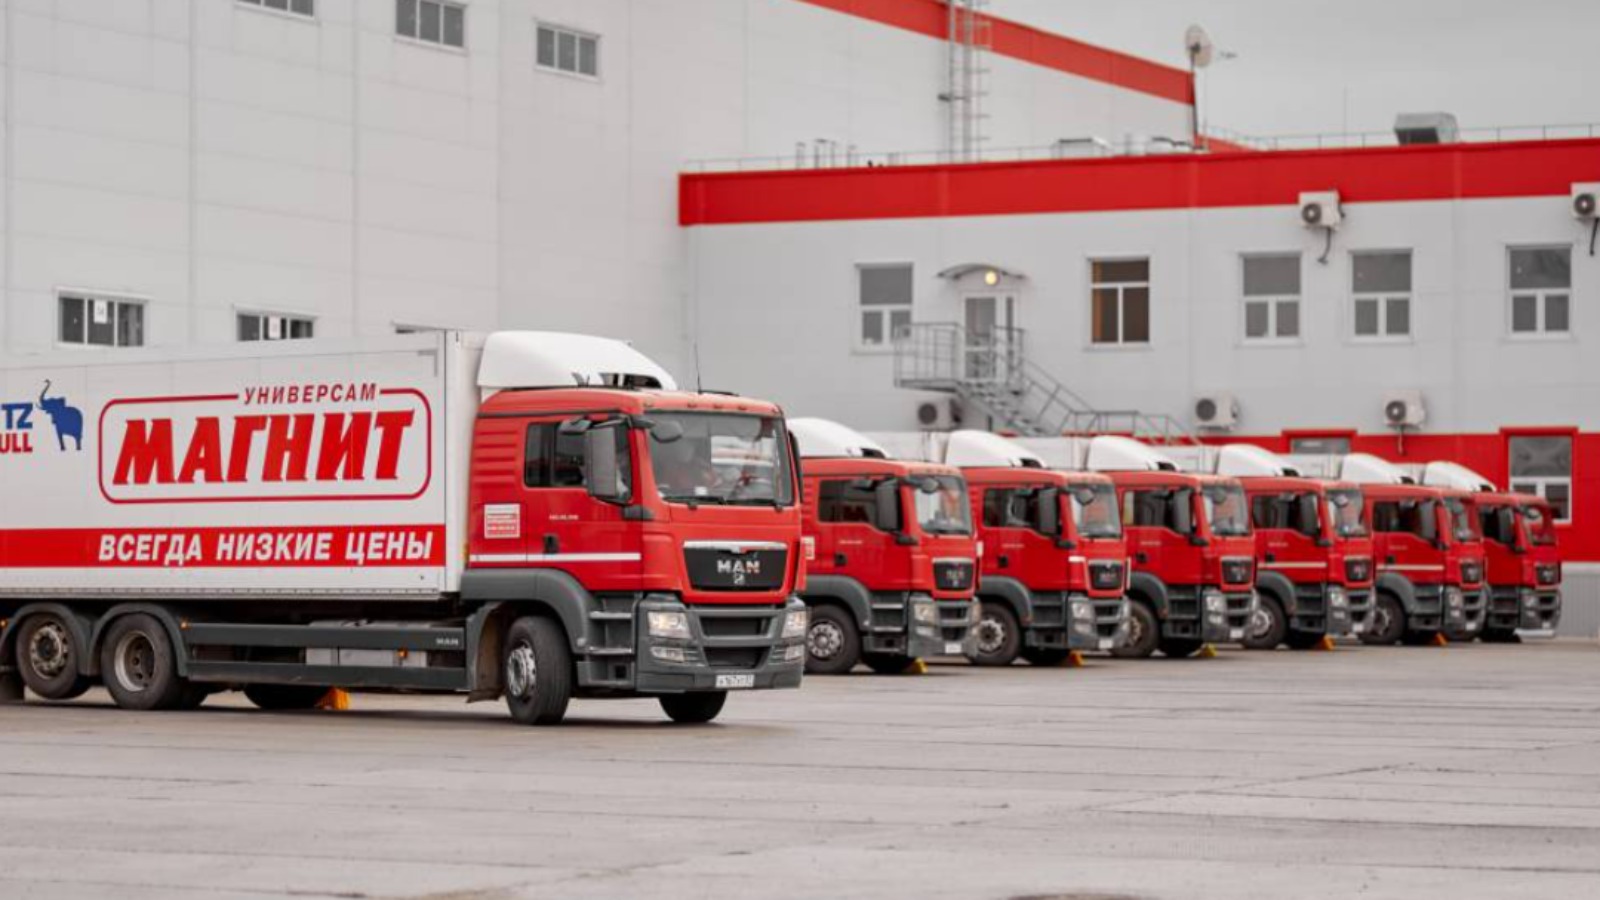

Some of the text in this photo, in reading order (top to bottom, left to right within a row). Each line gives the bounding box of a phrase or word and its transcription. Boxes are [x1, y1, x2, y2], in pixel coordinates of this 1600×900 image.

[244, 383, 376, 405] УНИВЕРСАМ
[112, 410, 414, 484] МАГНИТ
[98, 531, 433, 566] ВСЕГДА НИЗКИЕ ЦЕНЫ
[717, 560, 760, 573] MAN
